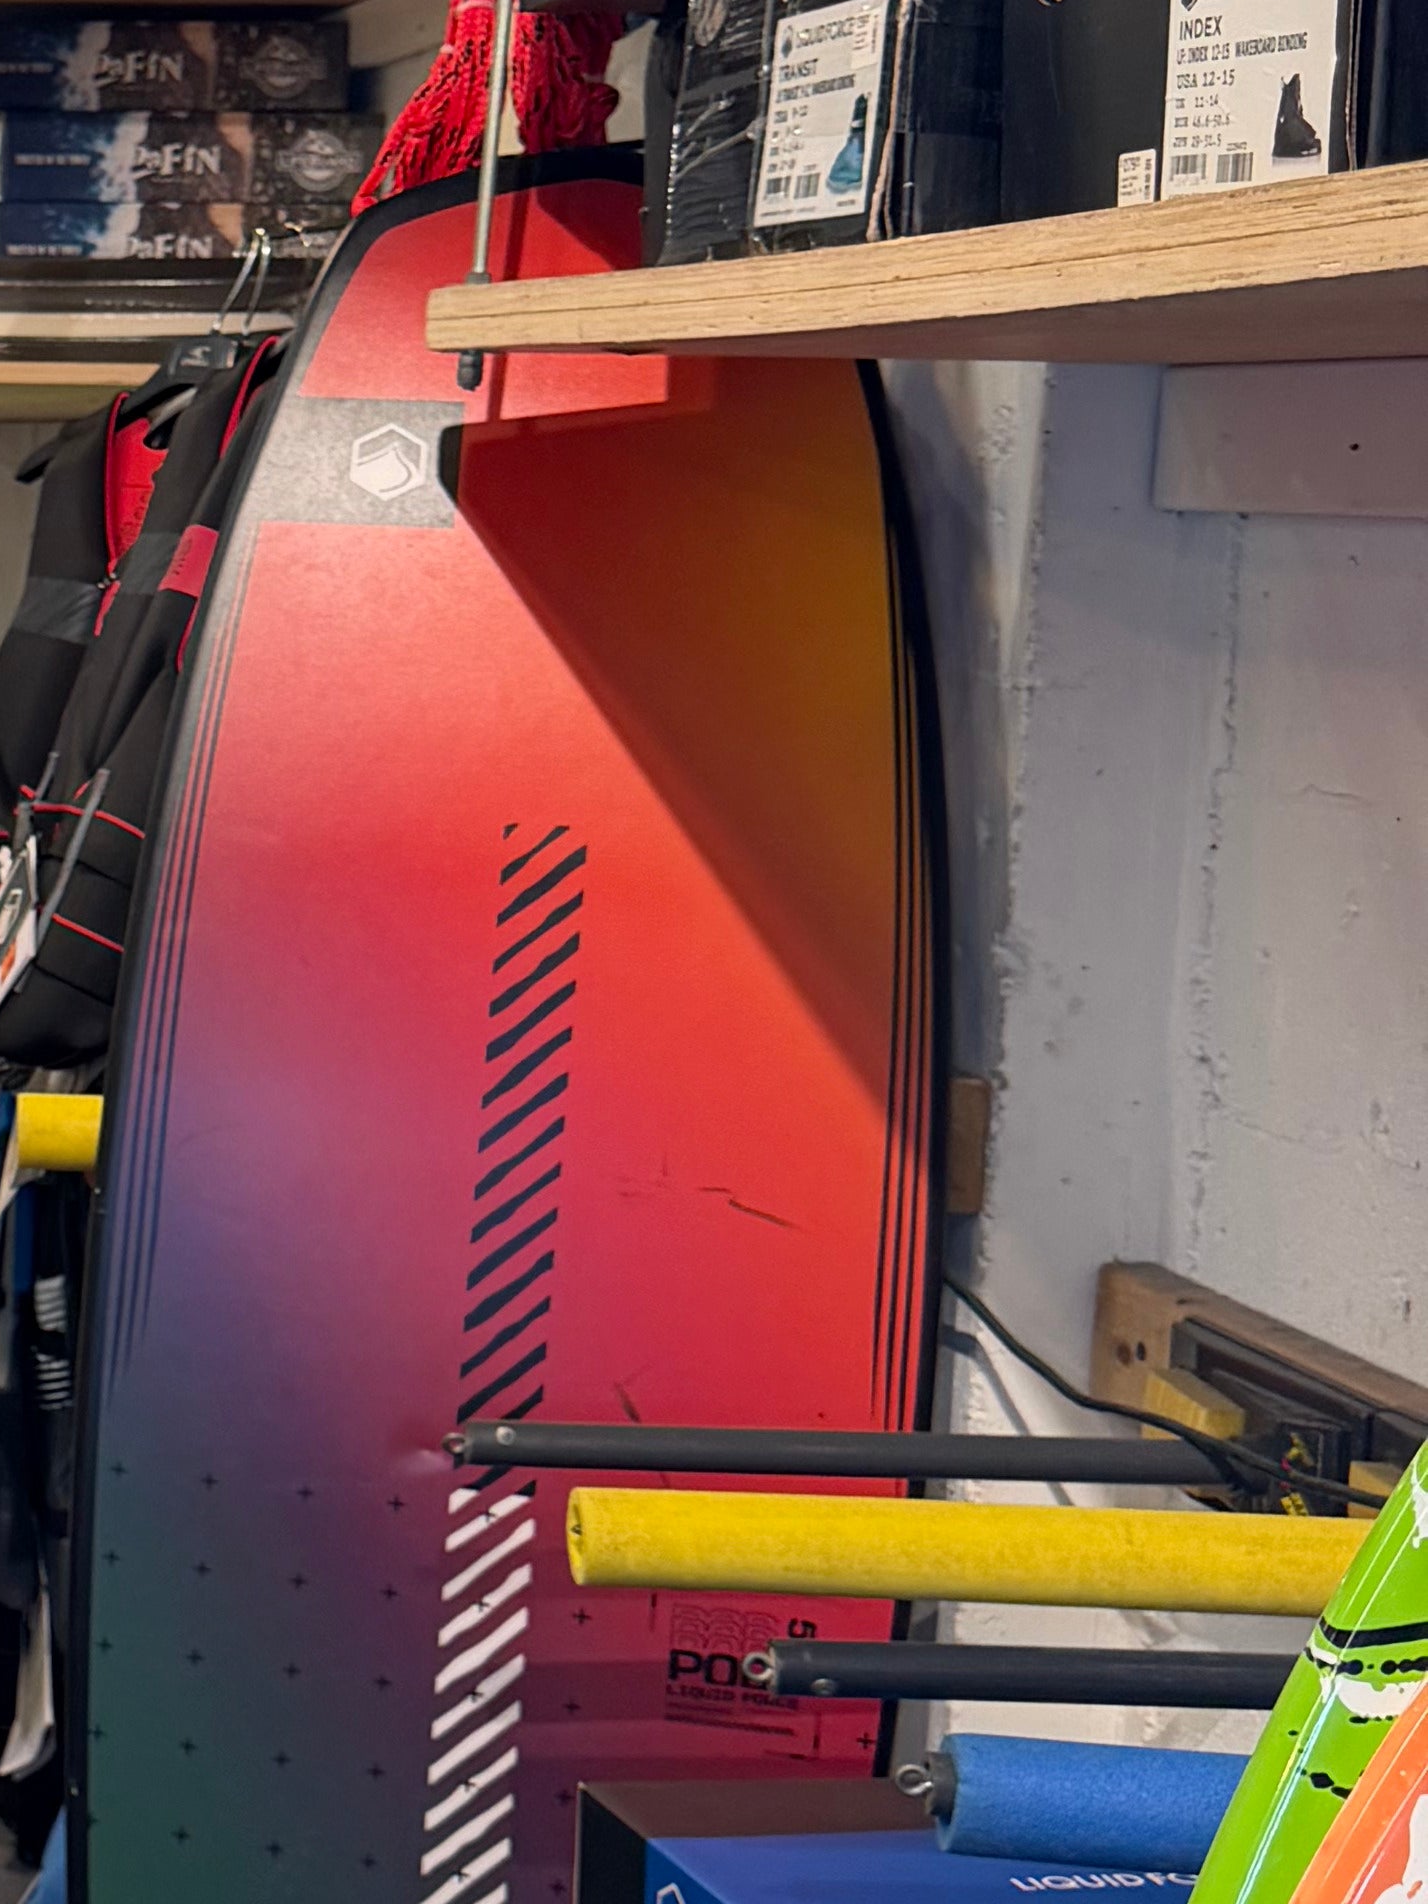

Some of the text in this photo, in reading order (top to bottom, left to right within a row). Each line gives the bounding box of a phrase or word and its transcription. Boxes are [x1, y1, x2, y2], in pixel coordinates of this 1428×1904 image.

[1179, 15, 1223, 41] INDEX
[1235, 34, 1277, 58] WAKEBOARD
[1176, 68, 1235, 89] USA 12-15
[1008, 1872, 1145, 1893] LIQUID
